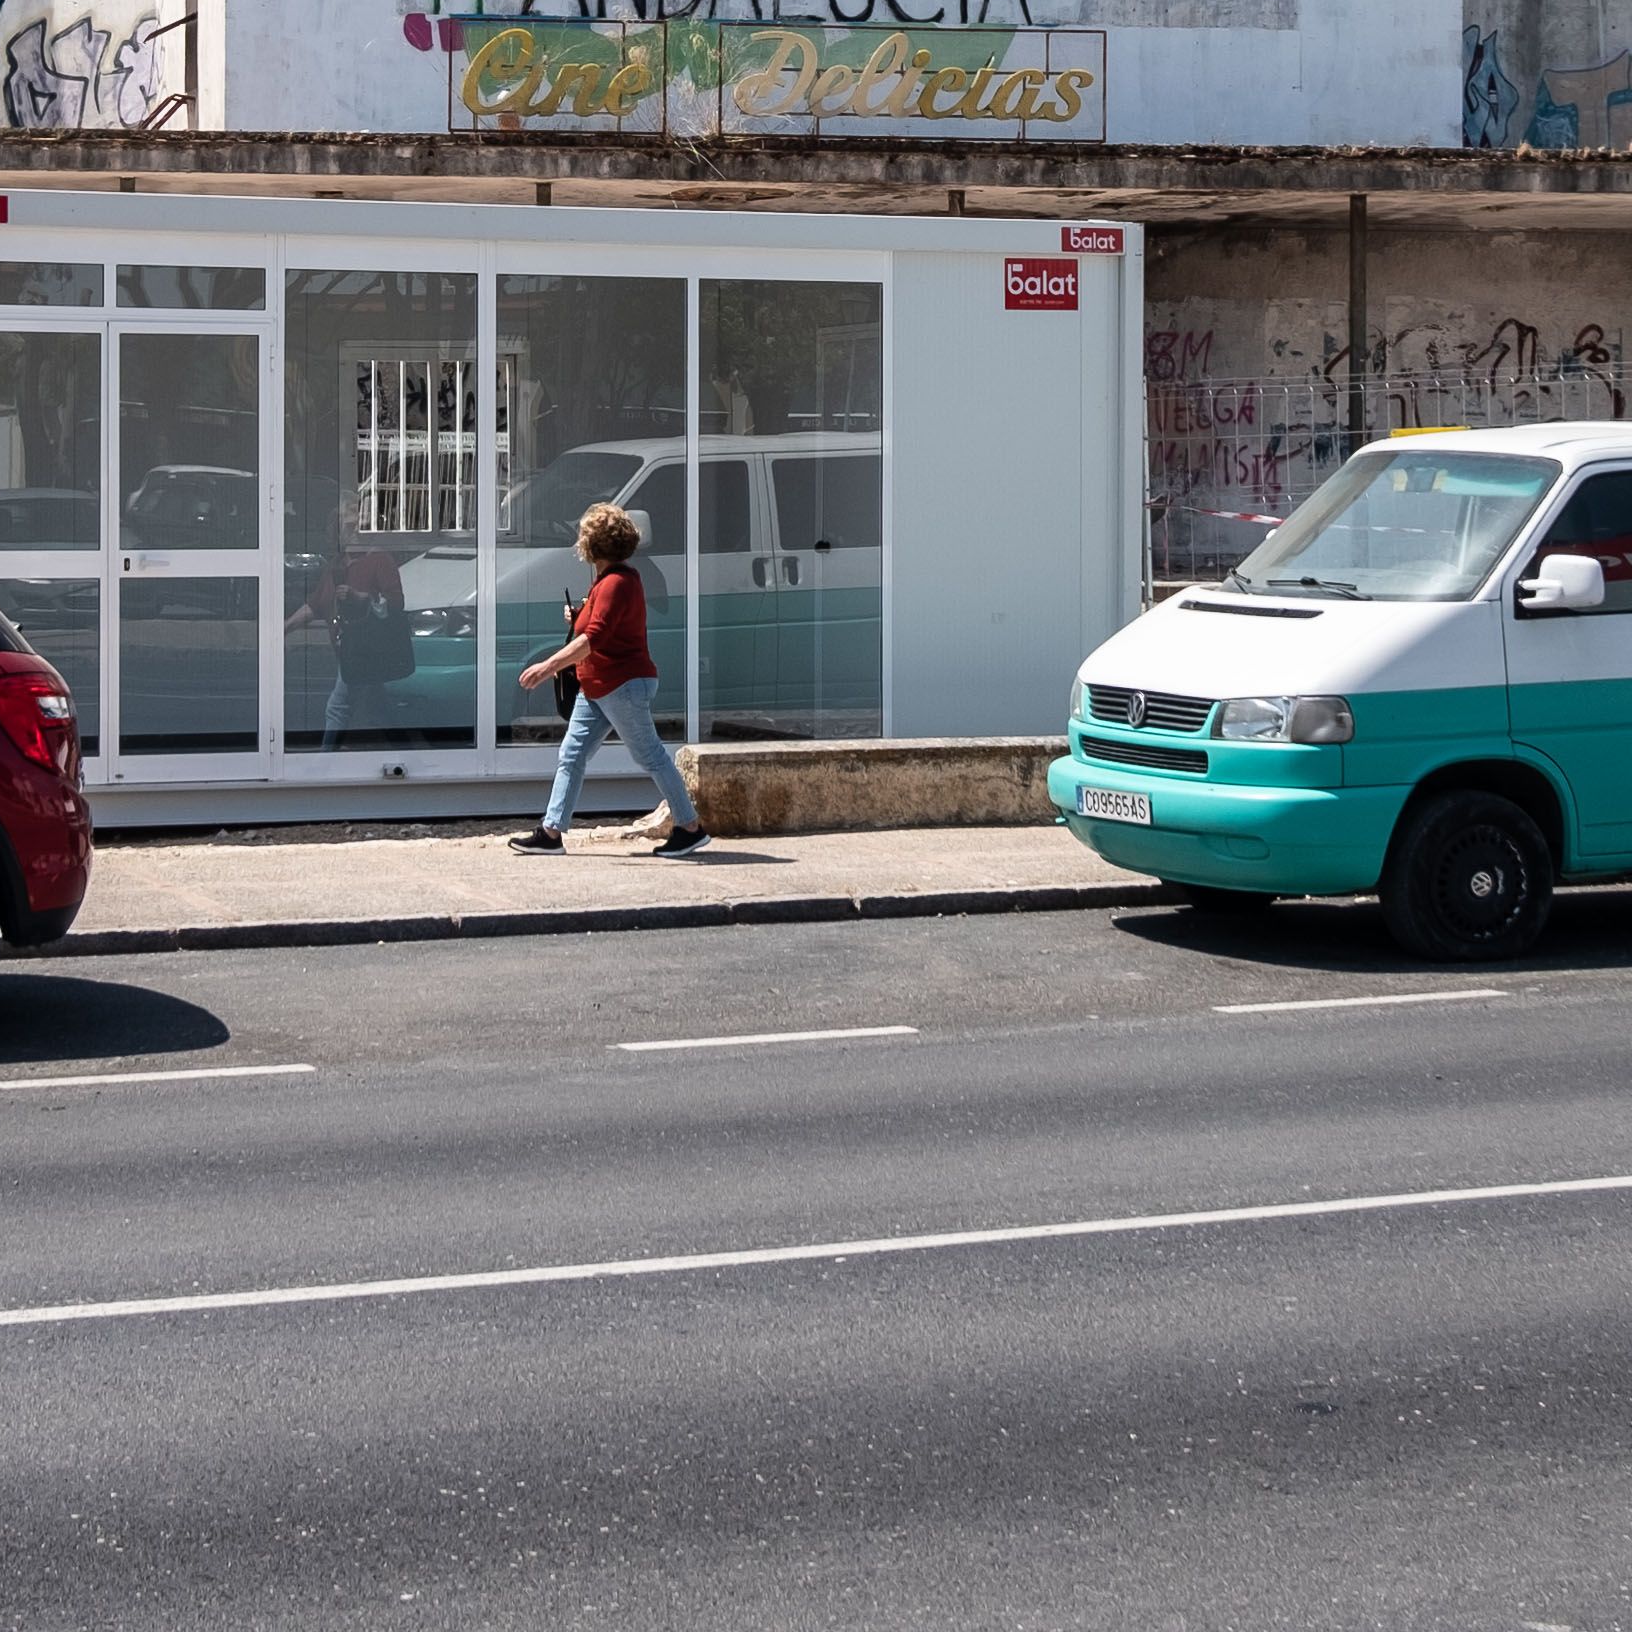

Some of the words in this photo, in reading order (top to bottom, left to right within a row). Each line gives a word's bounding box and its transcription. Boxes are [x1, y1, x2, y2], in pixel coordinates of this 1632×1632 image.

[460, 27, 654, 118] Cine
[730, 30, 1096, 124] Delicias
[1070, 227, 1116, 249] balat
[1007, 263, 1076, 296] balat
